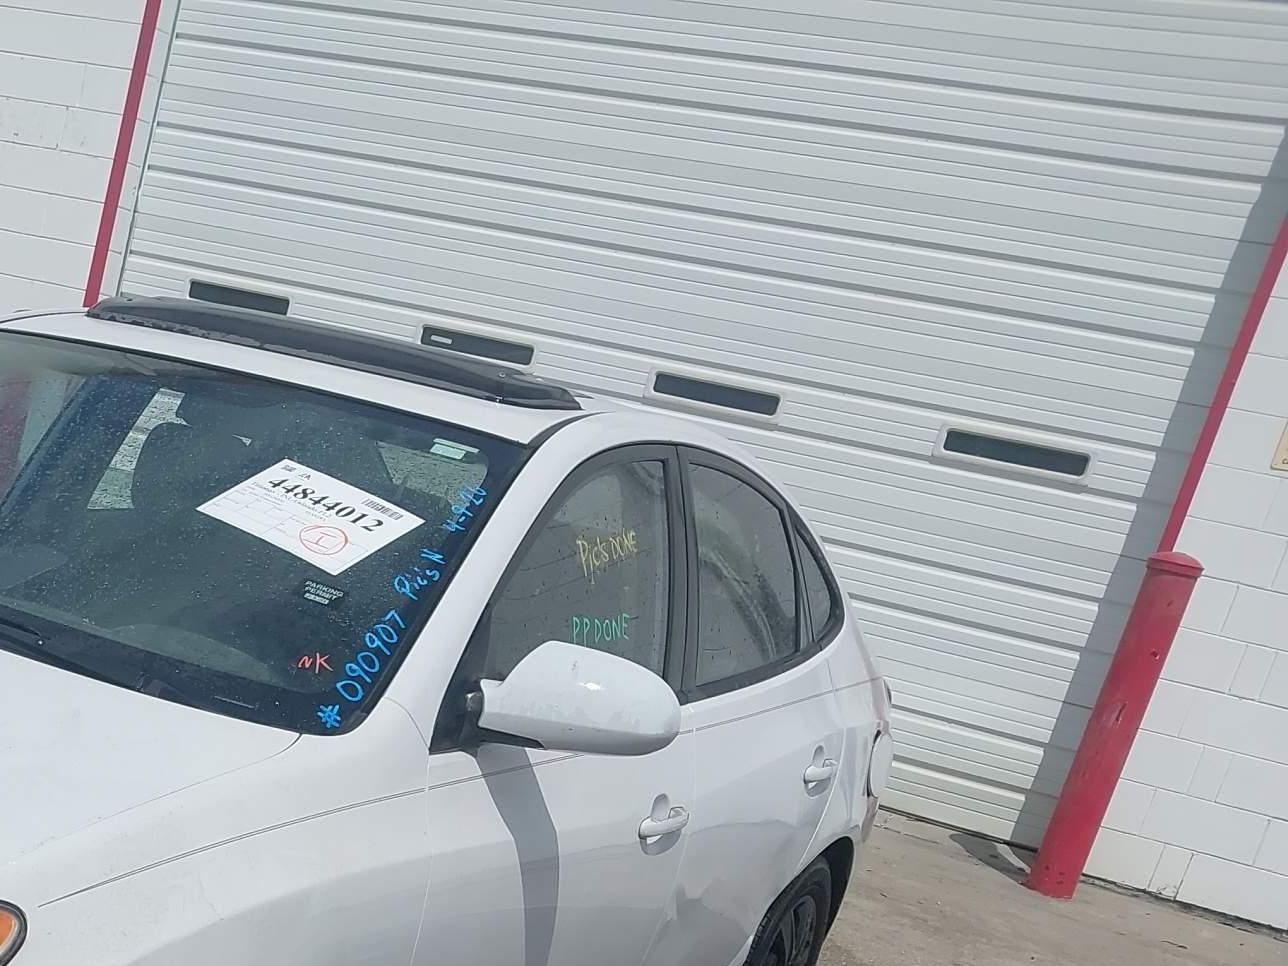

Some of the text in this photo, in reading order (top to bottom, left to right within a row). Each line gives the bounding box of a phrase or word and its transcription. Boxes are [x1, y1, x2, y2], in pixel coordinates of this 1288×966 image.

[268, 478, 384, 532] 44844012
[610, 528, 637, 560] DONE
[304, 586, 338, 601] PERMIT
[305, 581, 344, 598] PARKING
[594, 613, 630, 644] DONE
